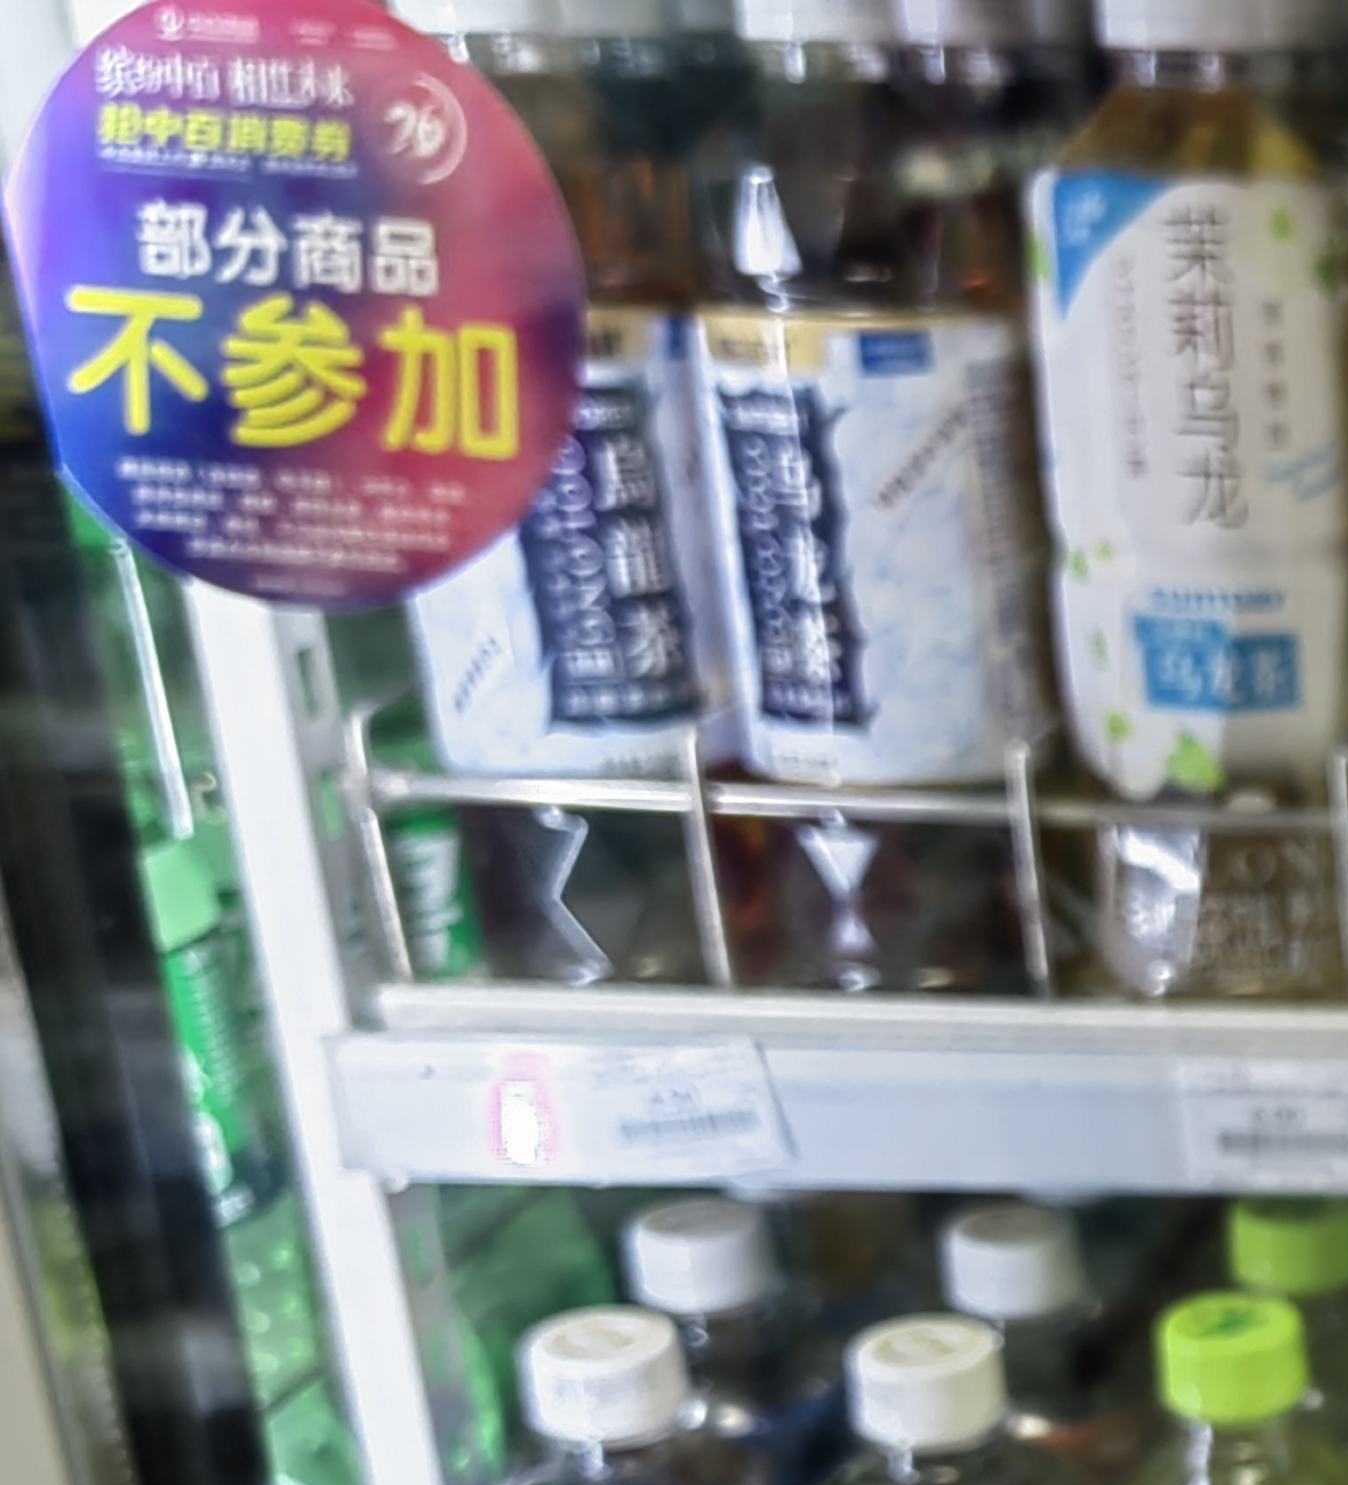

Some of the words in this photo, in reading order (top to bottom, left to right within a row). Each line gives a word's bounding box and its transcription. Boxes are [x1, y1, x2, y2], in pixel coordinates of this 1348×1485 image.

[136, 200, 440, 297] 部分商品
[67, 285, 520, 460] 不参加
[1165, 205, 1250, 532] 茉莉乌龙
